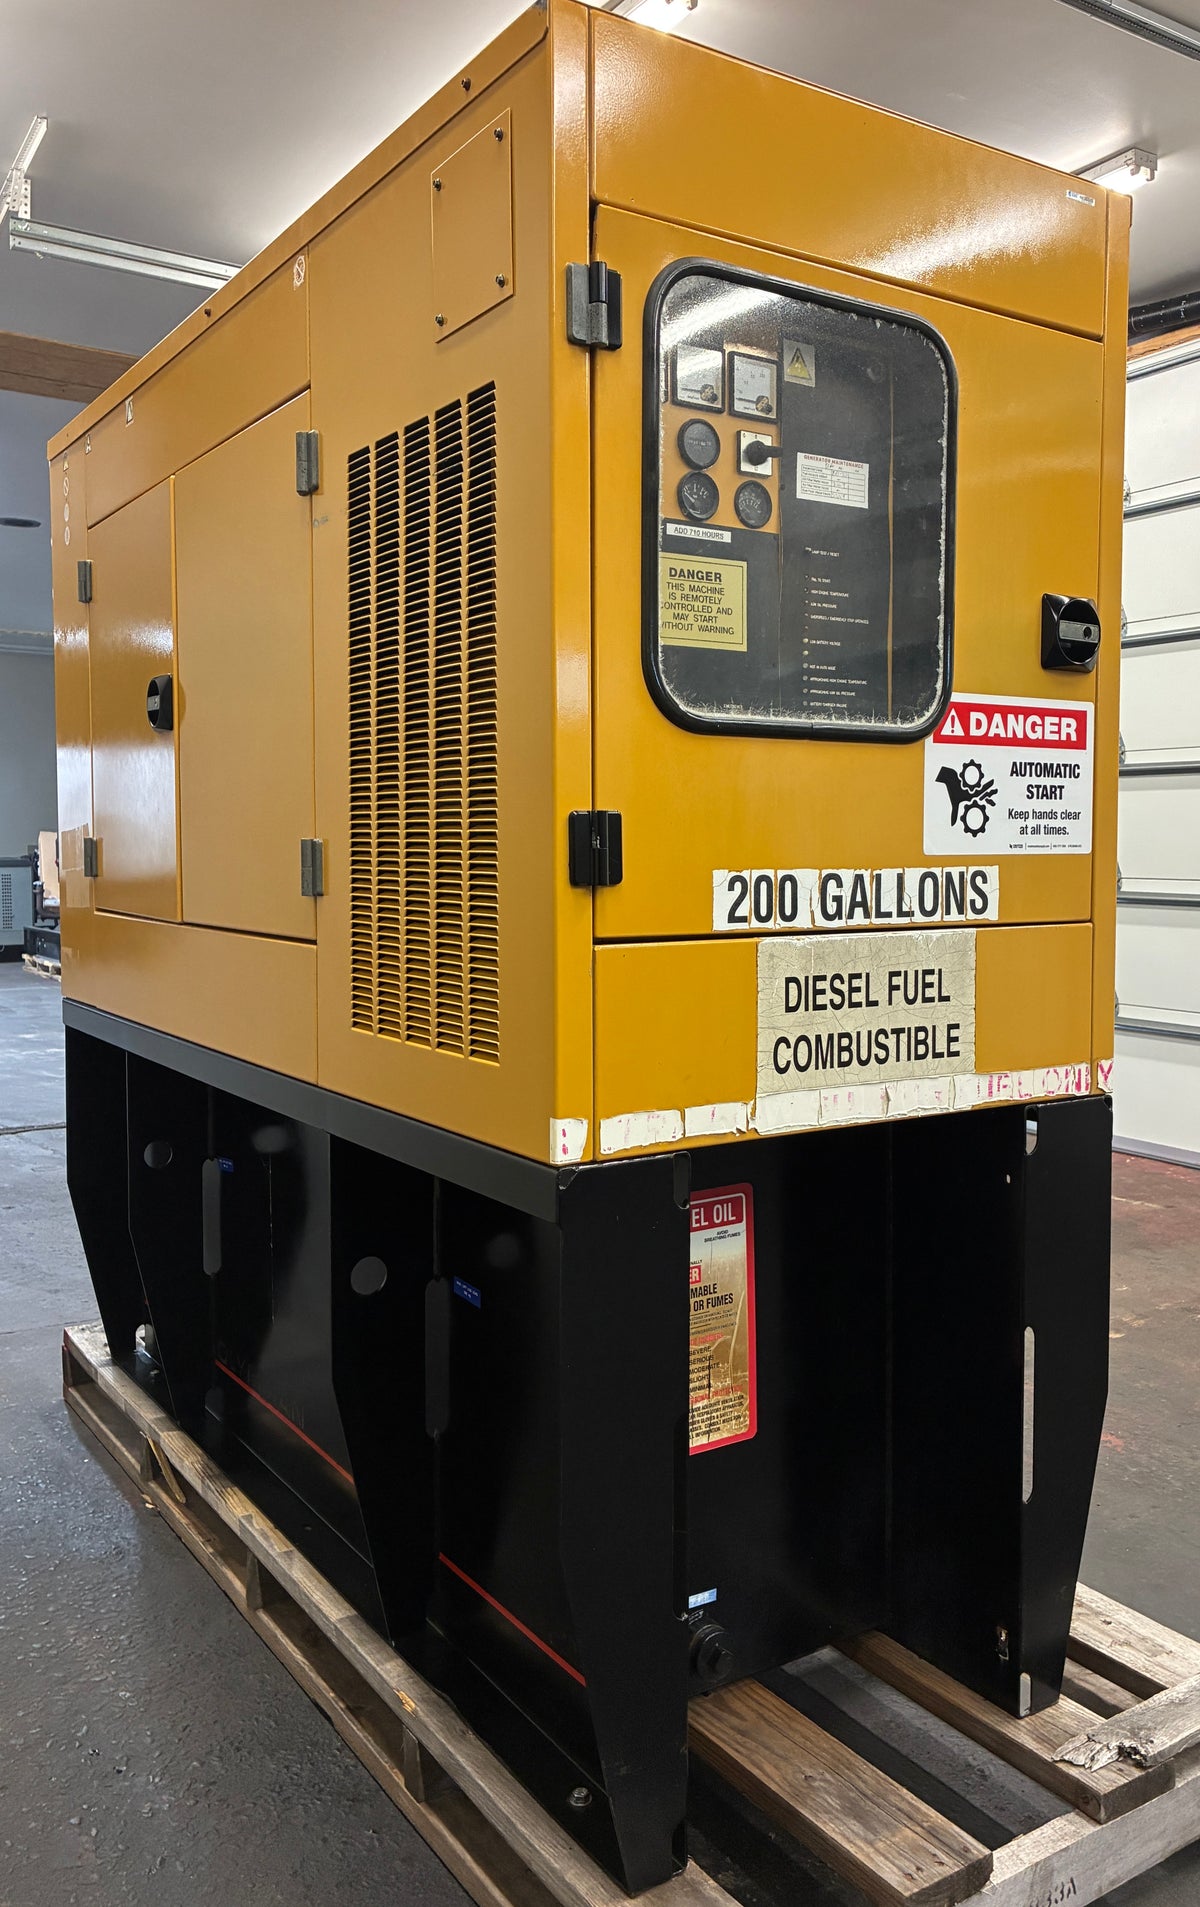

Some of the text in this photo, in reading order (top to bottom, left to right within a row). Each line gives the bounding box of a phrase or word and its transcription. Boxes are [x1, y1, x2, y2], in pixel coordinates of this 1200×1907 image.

[673, 526, 688, 536] ADD
[702, 530, 724, 541] HOURS
[669, 567, 722, 582] DANGER
[666, 582, 725, 596] THIS MACHINE
[668, 593, 722, 605] IS REMOTELY
[673, 612, 718, 624] MAY START
[716, 608, 732, 616] AND
[698, 624, 735, 635] WARNING
[969, 711, 1077, 742] DANGER
[1010, 761, 1081, 779] AUTOMATIC
[1026, 784, 1065, 800] START
[1008, 808, 1082, 822] Keep hands clear
[1019, 824, 1070, 836] at all times.
[727, 870, 989, 924] 200 GALLONS
[784, 968, 951, 1014] DIESEL FUEL
[773, 1023, 961, 1075] COMBUSTIBLE
[713, 1202, 736, 1224] OIL
[693, 1292, 734, 1312] OR FUMES
